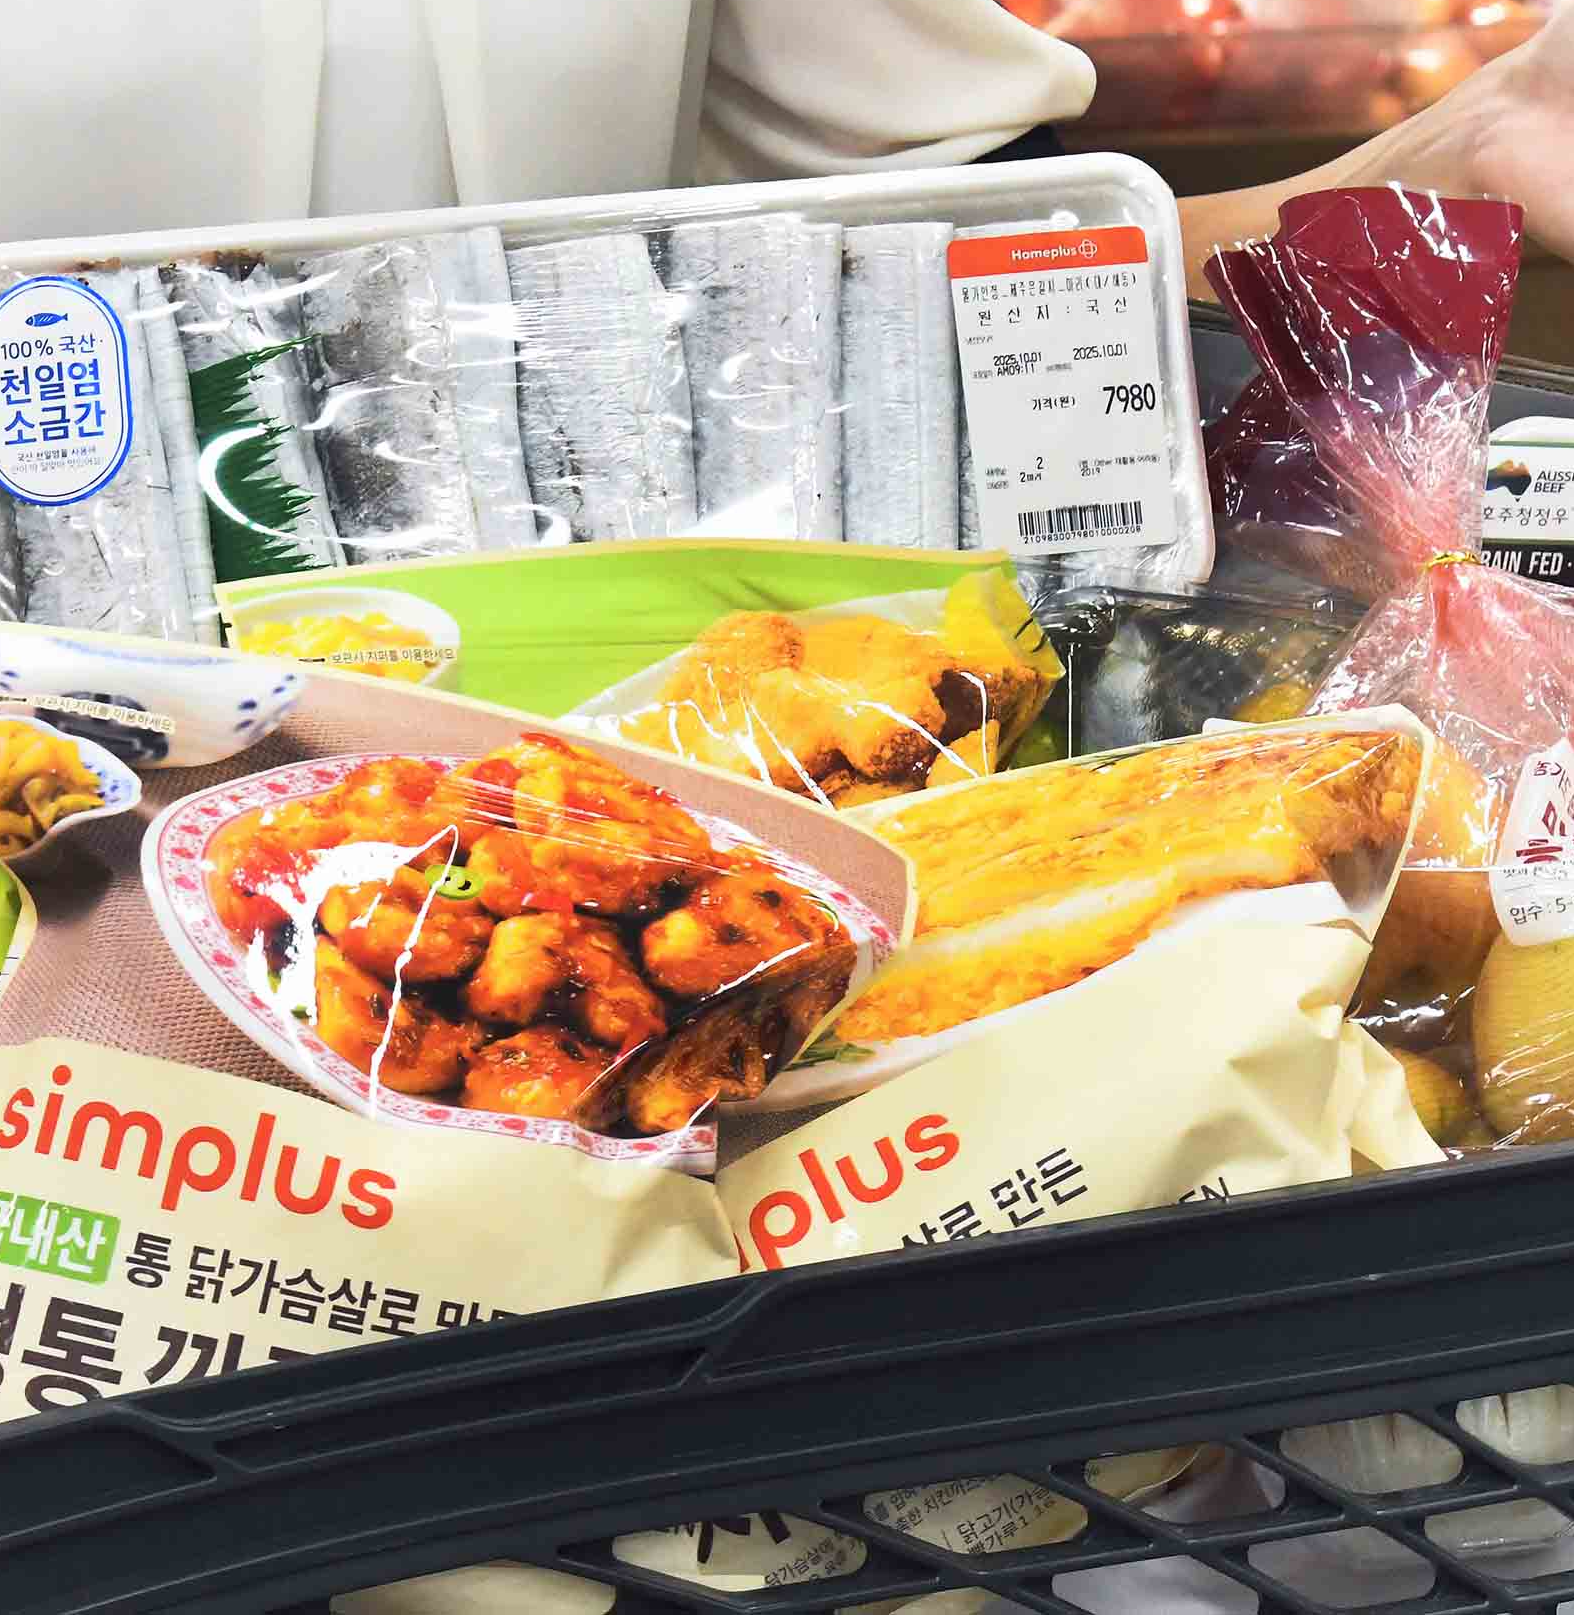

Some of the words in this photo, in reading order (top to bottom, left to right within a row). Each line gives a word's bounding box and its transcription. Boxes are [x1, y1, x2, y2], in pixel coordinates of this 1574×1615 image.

[1011, 246, 1077, 262] Homeplus
[0, 338, 54, 361] 100%
[58, 333, 97, 354] 국산
[993, 351, 1042, 367] 2025.10.01
[1072, 342, 1129, 361] 2025.10.01
[0, 358, 101, 405] 천일염
[1102, 382, 1156, 415] 7980
[4, 400, 106, 445] 소금간
[1036, 456, 1044, 470] 2
[1534, 482, 1566, 494] BEEF
[1481, 550, 1522, 575] RAIN
[1529, 551, 1564, 576] FED
[1509, 903, 1544, 926] 입수
[732, 1113, 961, 1272] plus
[990, 1147, 1089, 1230] 만든
[125, 1232, 172, 1289] 통
[184, 1245, 421, 1337] 닭가슴살로
